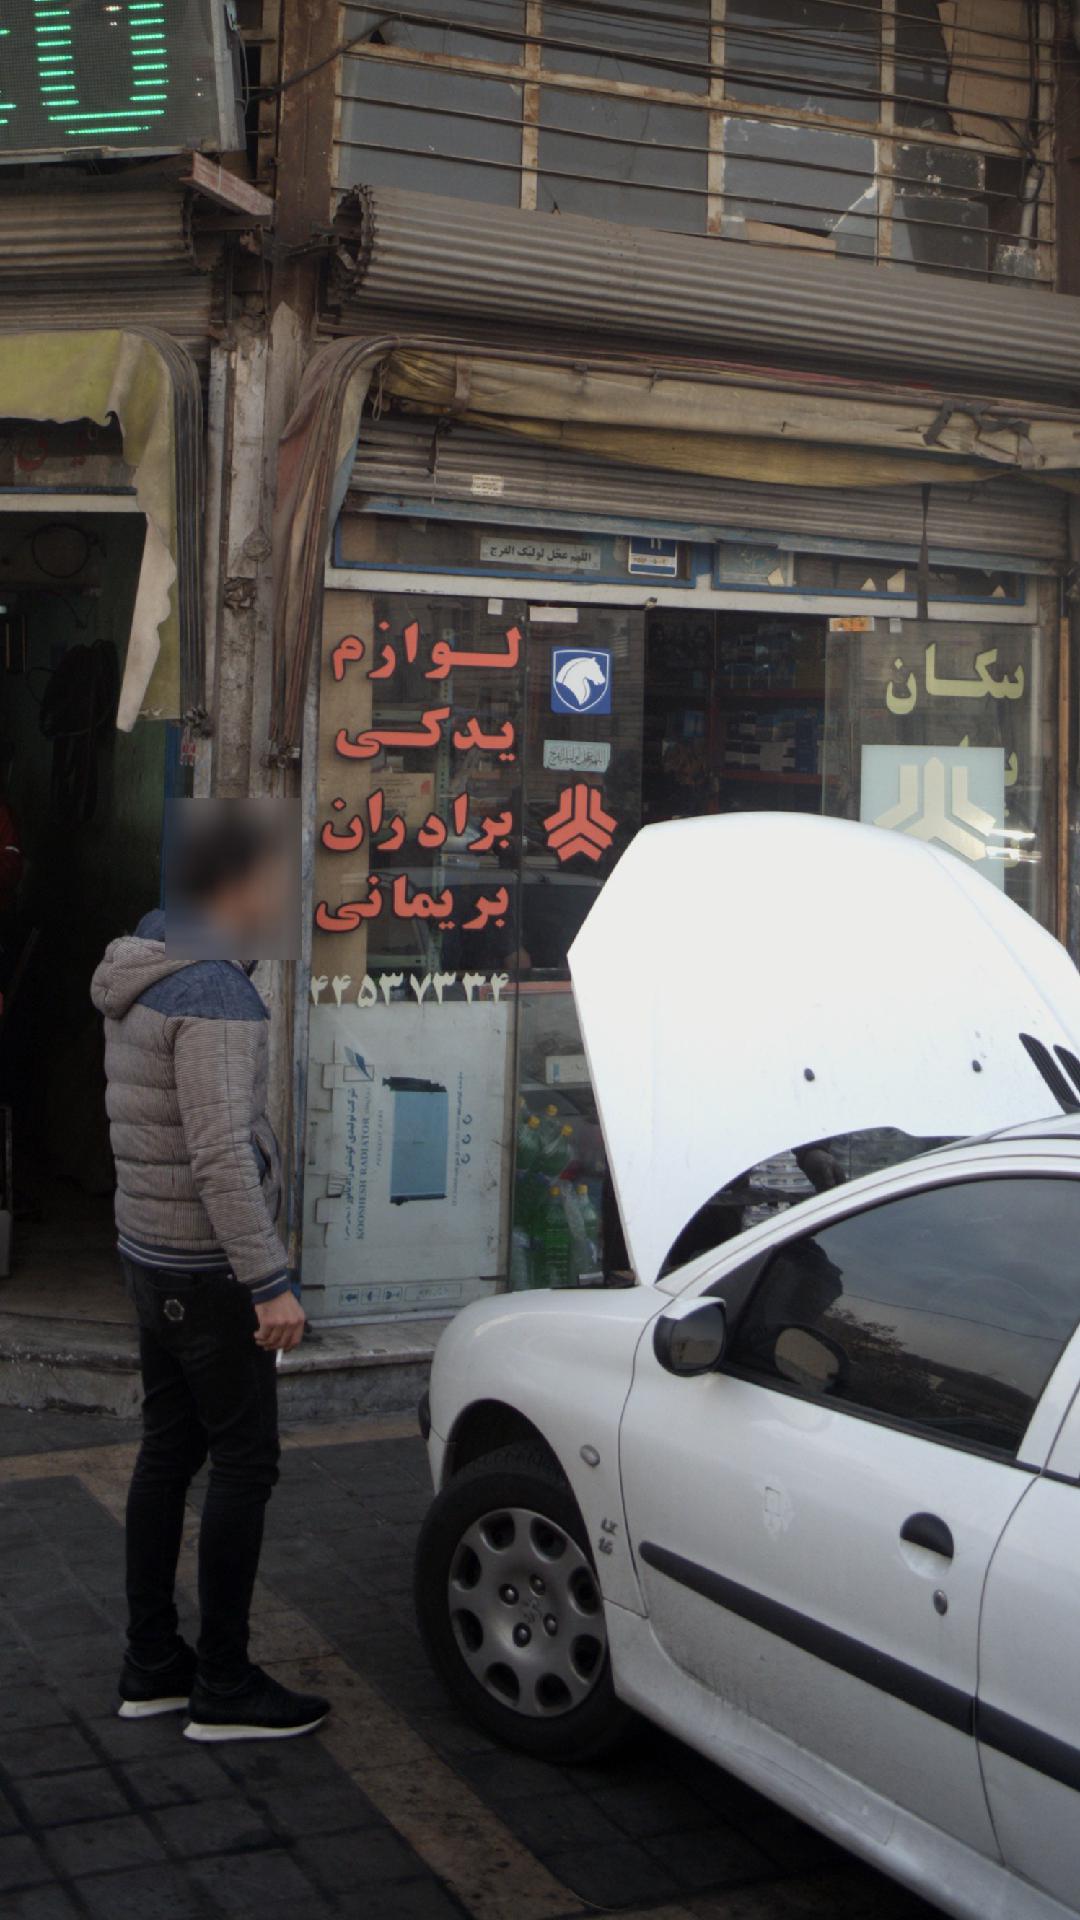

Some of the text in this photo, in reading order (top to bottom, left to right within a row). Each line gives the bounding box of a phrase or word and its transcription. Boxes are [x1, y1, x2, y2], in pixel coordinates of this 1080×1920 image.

[332, 621, 522, 680] لوازم
[335, 707, 516, 761] یدکی
[323, 792, 513, 850] برادران
[316, 876, 509, 930] بریمانی
[358, 1117, 370, 1176] RADIATOR
[355, 1180, 367, 1240] KOOSHESH
